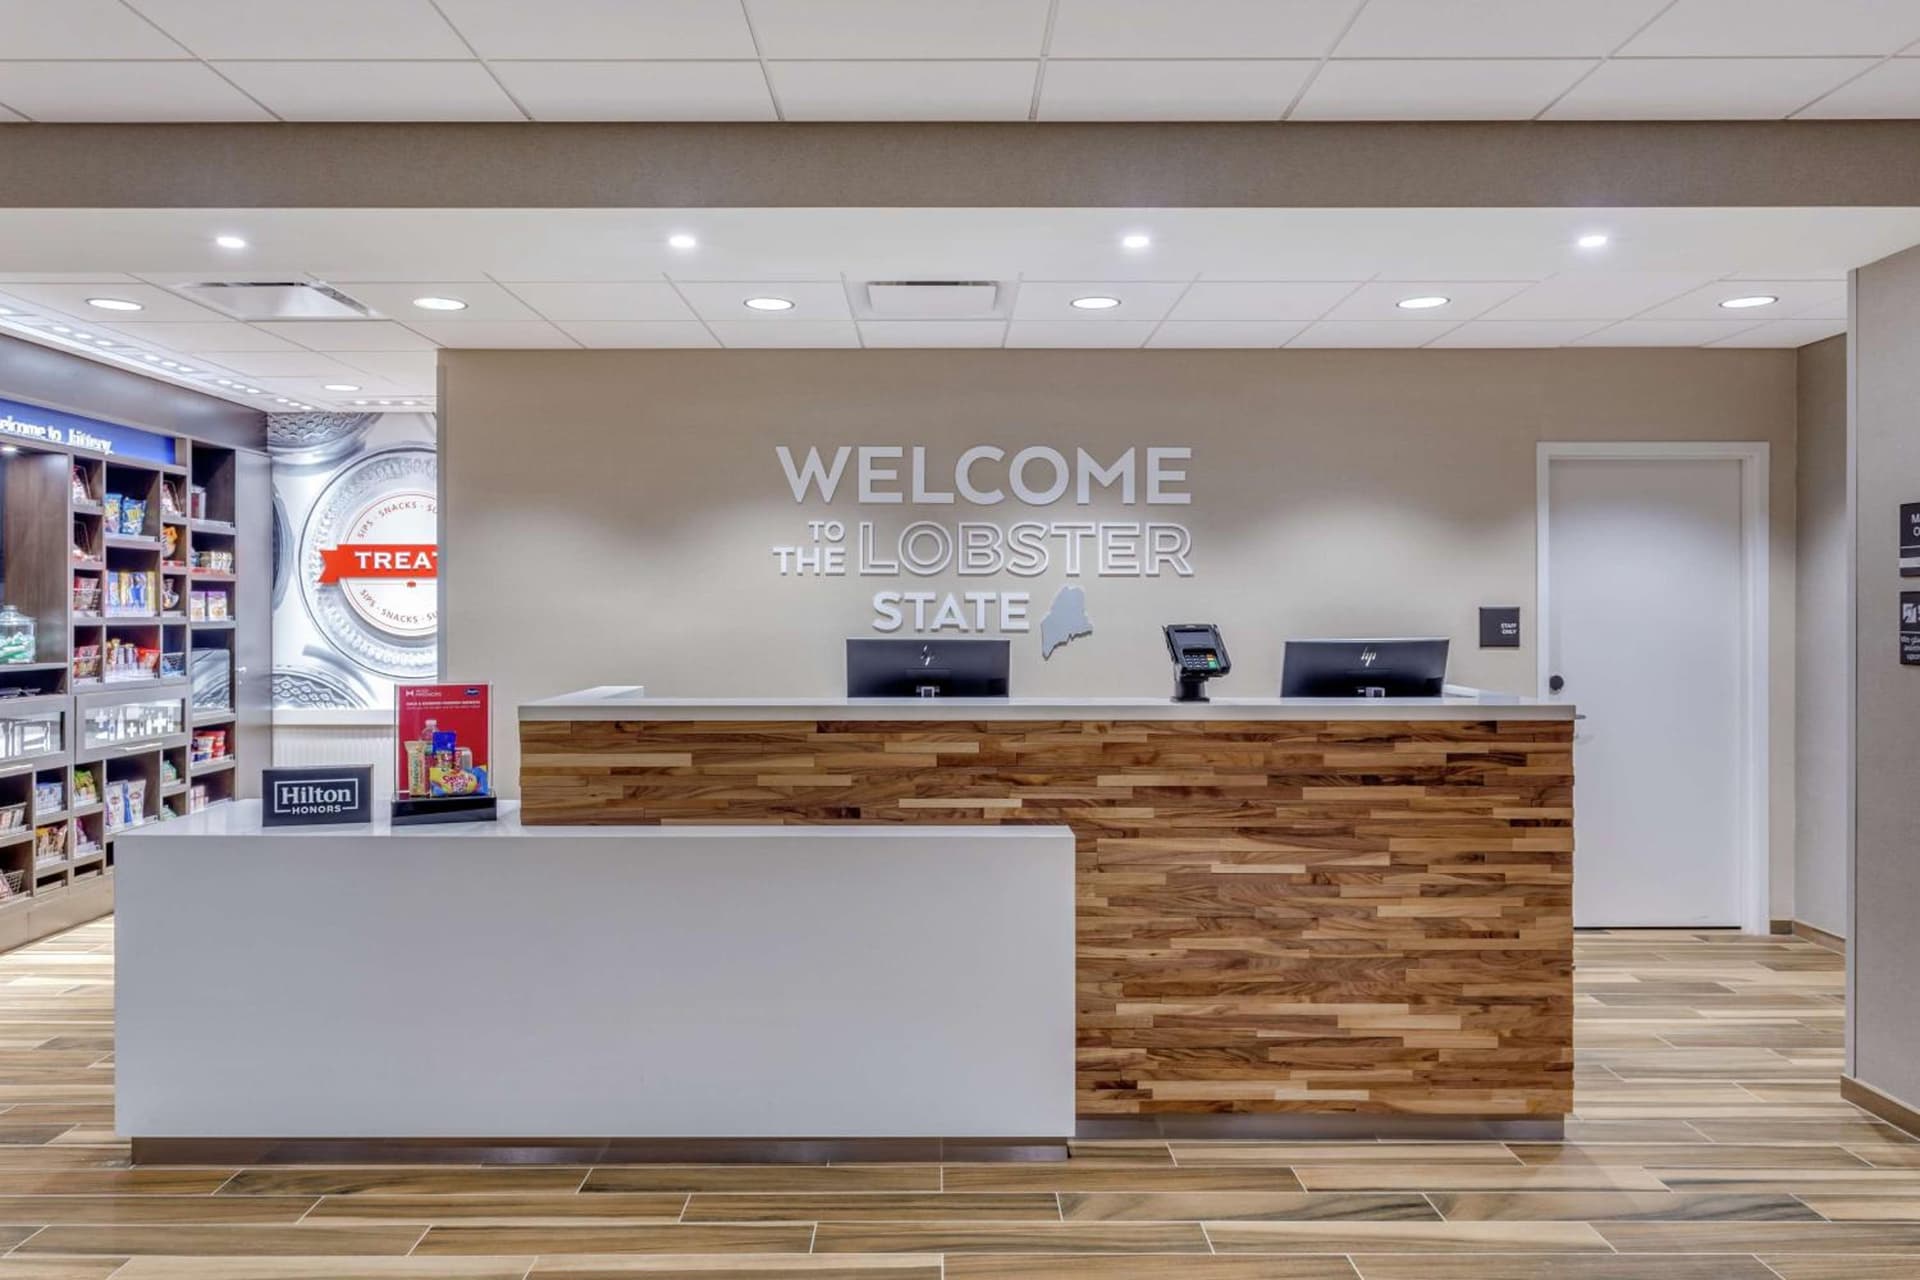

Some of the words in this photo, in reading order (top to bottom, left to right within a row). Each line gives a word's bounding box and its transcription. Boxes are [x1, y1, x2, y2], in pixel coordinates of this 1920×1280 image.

[0, 415, 46, 438] elcome
[47, 425, 62, 441] to
[775, 445, 1192, 505] WELCOME
[357, 520, 373, 539] SIPS
[378, 501, 417, 518] SNACKS
[808, 520, 845, 542] TO
[772, 546, 846, 575] THE
[858, 520, 1195, 576] LOBSTER
[361, 588, 377, 607] SIPS
[380, 608, 419, 624] SNACKS
[872, 591, 1030, 633] STATE
[281, 786, 352, 805] Hilton
[291, 804, 342, 815] HONORS
